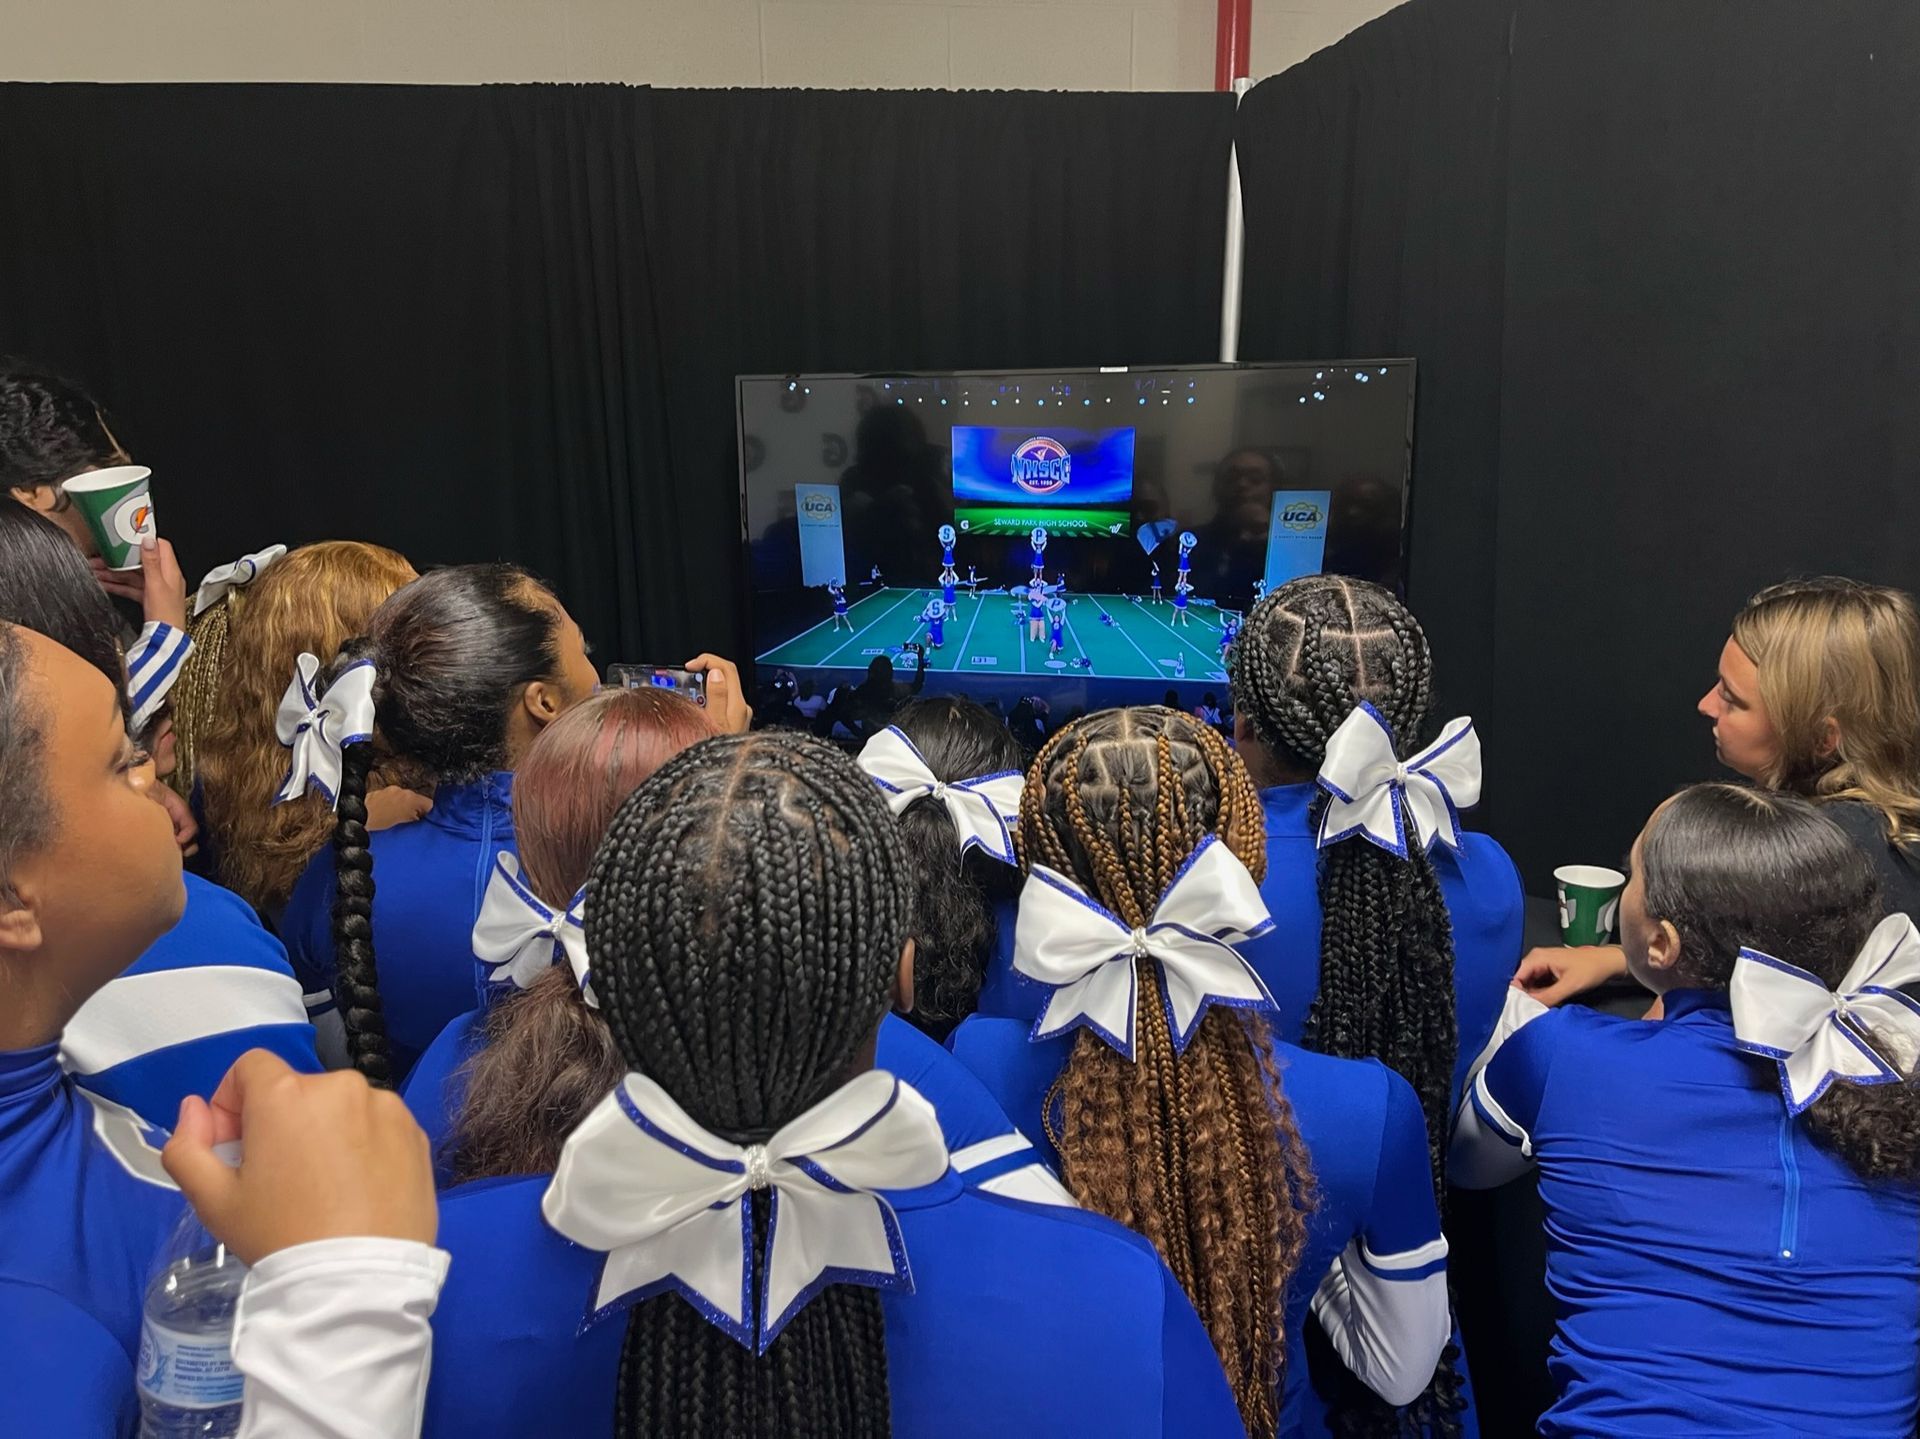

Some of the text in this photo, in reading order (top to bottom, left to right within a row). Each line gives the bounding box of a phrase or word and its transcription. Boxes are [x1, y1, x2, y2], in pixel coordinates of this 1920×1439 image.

[804, 502, 833, 512] UCA
[1283, 511, 1318, 522] UCA
[993, 517, 1020, 526] SEWARD
[1038, 519, 1057, 527] HIGH
[1058, 519, 1088, 528] SCHOOL
[943, 528, 950, 540] S
[1035, 529, 1043, 542] P
[932, 600, 940, 615] S
[1051, 600, 1061, 608] P
